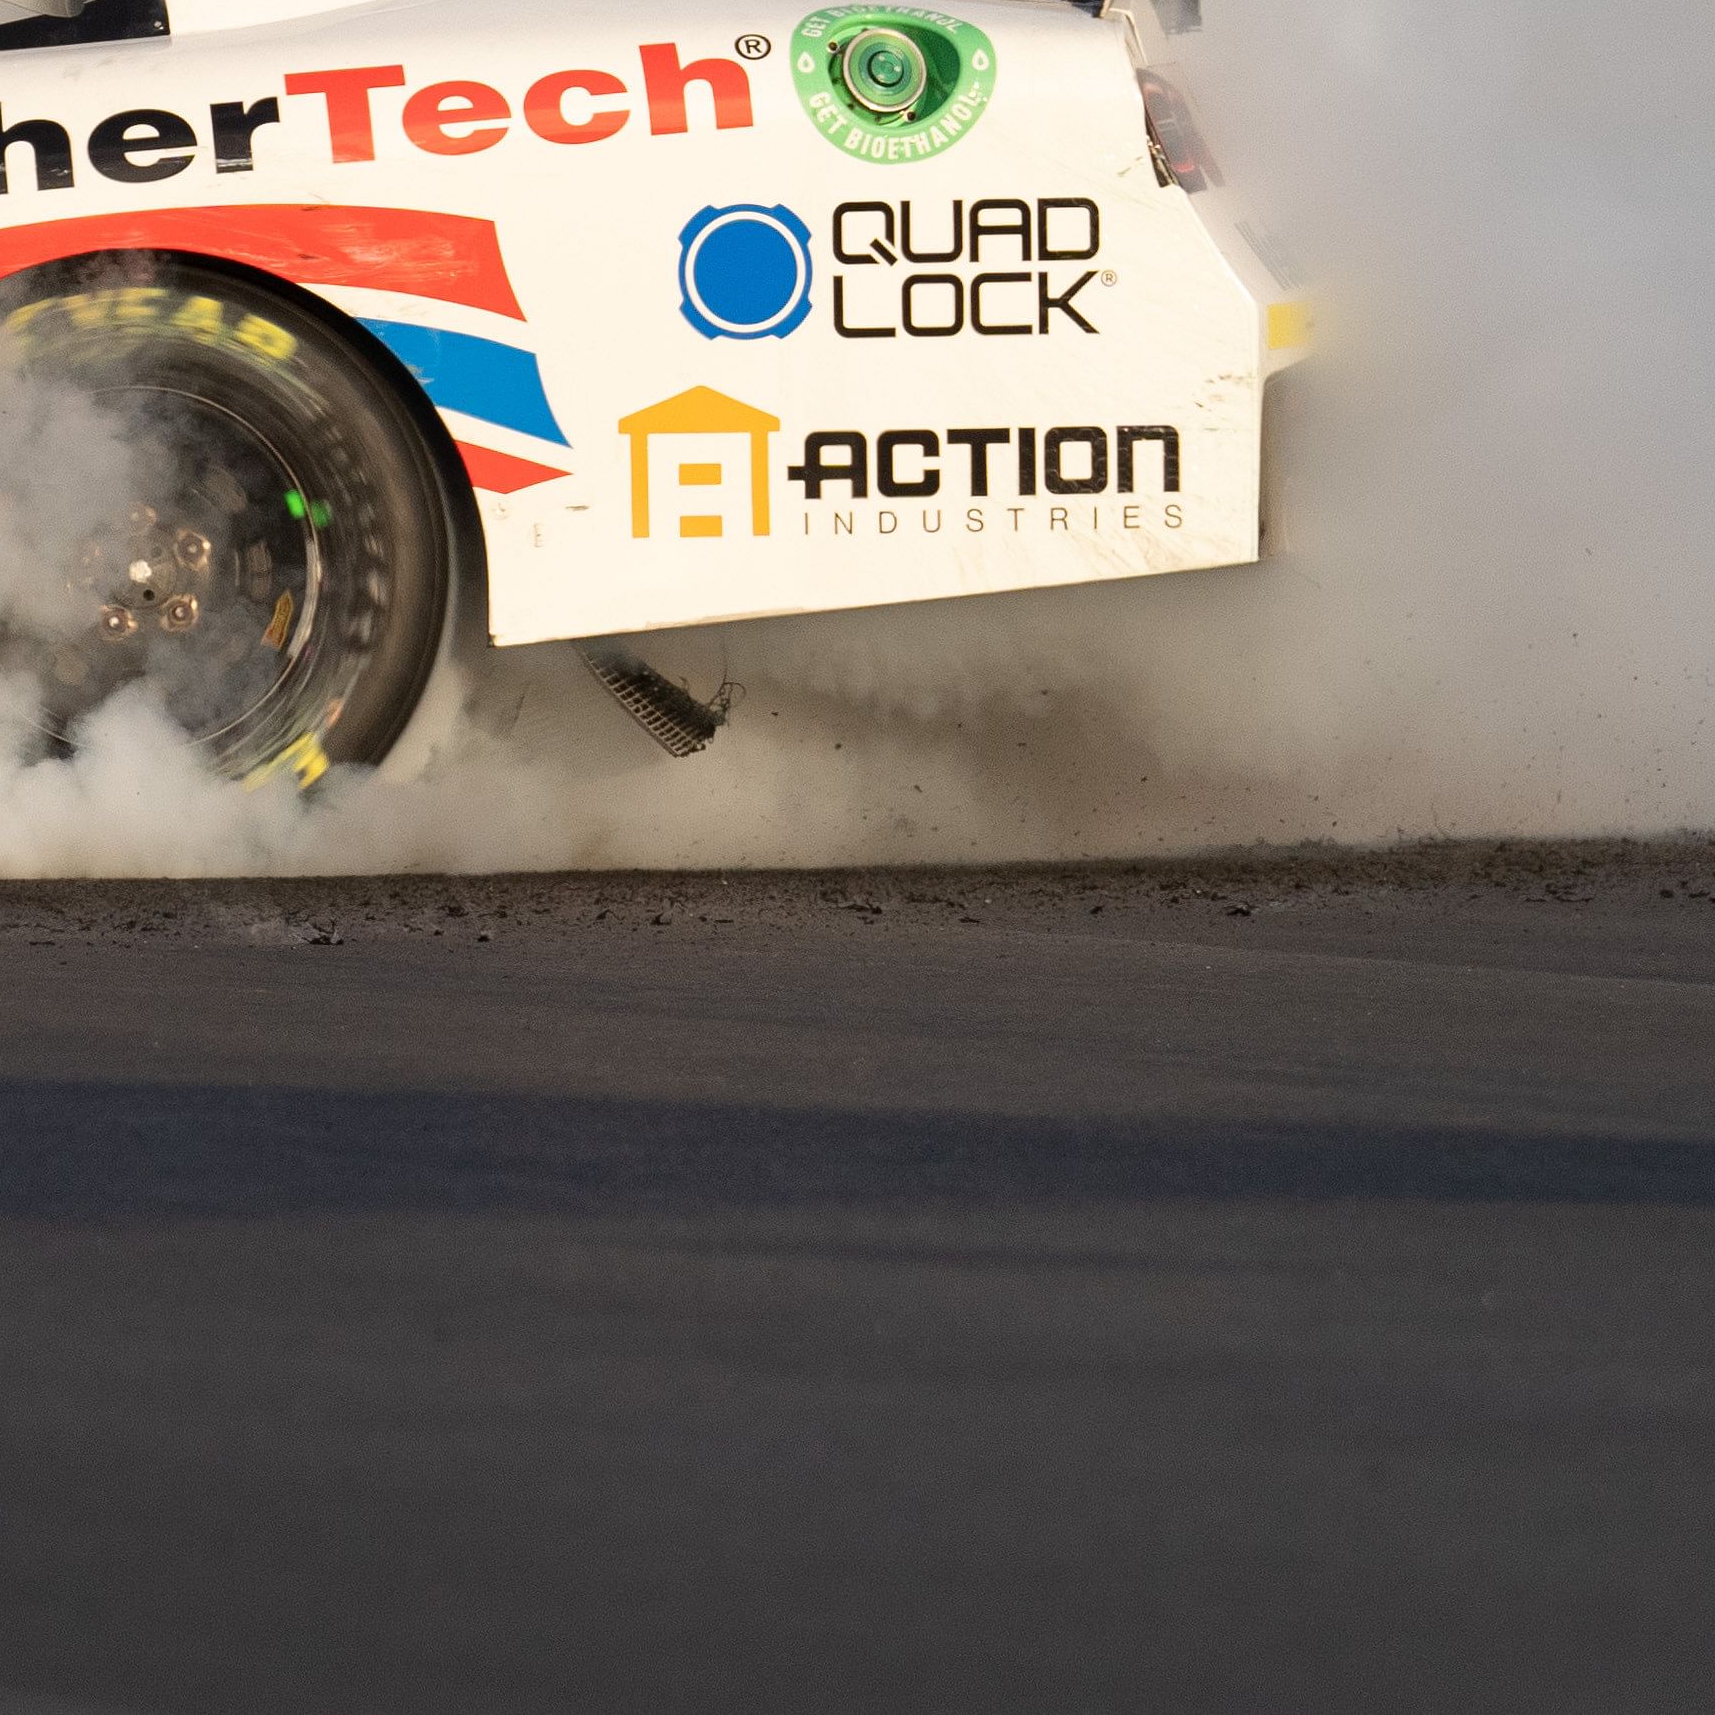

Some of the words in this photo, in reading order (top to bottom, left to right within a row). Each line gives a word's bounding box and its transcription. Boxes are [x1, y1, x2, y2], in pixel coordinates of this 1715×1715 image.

[802, 16, 832, 38] GET
[809, 92, 847, 134] GET
[843, 93, 983, 160] BIOETHANOL
[832, 197, 1100, 266] QUAD
[787, 425, 1180, 499] ACTION
[804, 504, 1184, 536] INDUSTRIES
